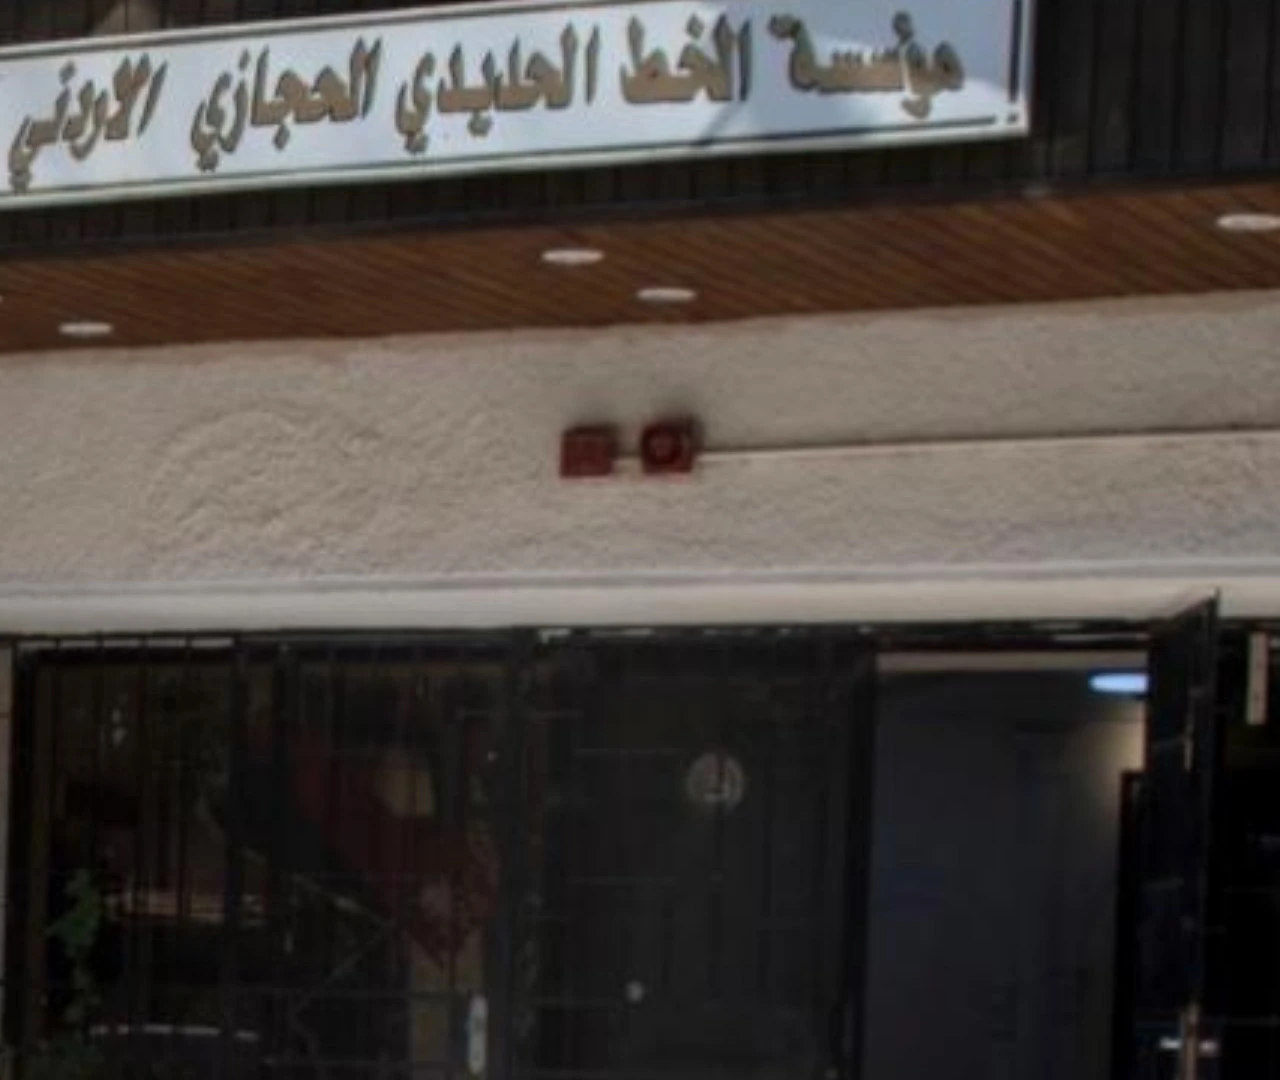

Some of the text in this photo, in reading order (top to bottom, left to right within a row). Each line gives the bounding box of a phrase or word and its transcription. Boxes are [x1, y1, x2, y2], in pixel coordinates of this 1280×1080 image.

[190, 37, 381, 173] الحجازي
[396, 21, 600, 156] الحديدي
[620, 14, 753, 104] الخط
[768, 10, 964, 120] مؤسسة
